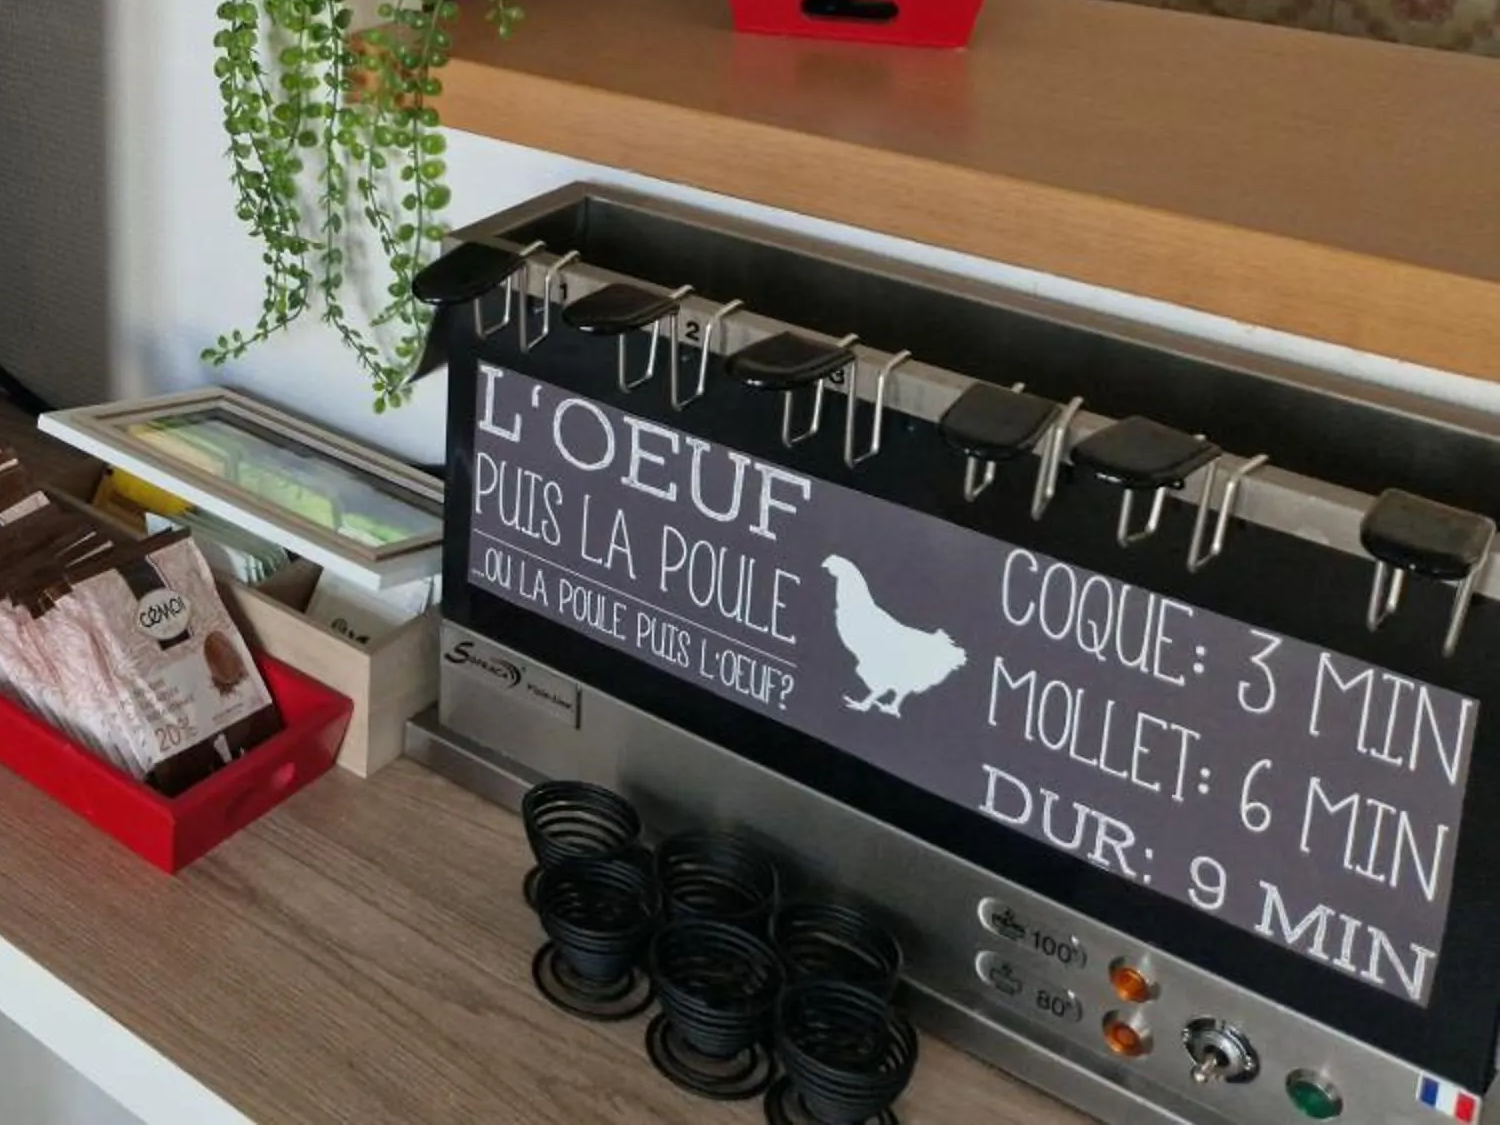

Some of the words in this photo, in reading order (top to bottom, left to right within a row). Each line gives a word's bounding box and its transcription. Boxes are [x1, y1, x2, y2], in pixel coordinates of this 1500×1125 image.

[559, 283, 568, 300] 1
[684, 321, 701, 341] 2
[477, 365, 811, 540] L'OEUF
[475, 452, 563, 546] PUIS
[580, 494, 637, 581] LA
[658, 525, 801, 643] POULE
[519, 572, 549, 608] LA
[558, 579, 627, 641] POULE
[636, 612, 692, 669] PUIS
[700, 642, 796, 711] L'OEUF?
[1002, 548, 1208, 686] COQUE:
[1237, 629, 1283, 714] 3
[1309, 651, 1476, 786] MIN
[988, 656, 1211, 803] MOLLET:
[1240, 758, 1274, 832] 6
[1299, 777, 1450, 903] MIN
[978, 764, 1154, 884] DUR:
[1187, 857, 1228, 912] 9
[1253, 879, 1437, 1001] MIN
